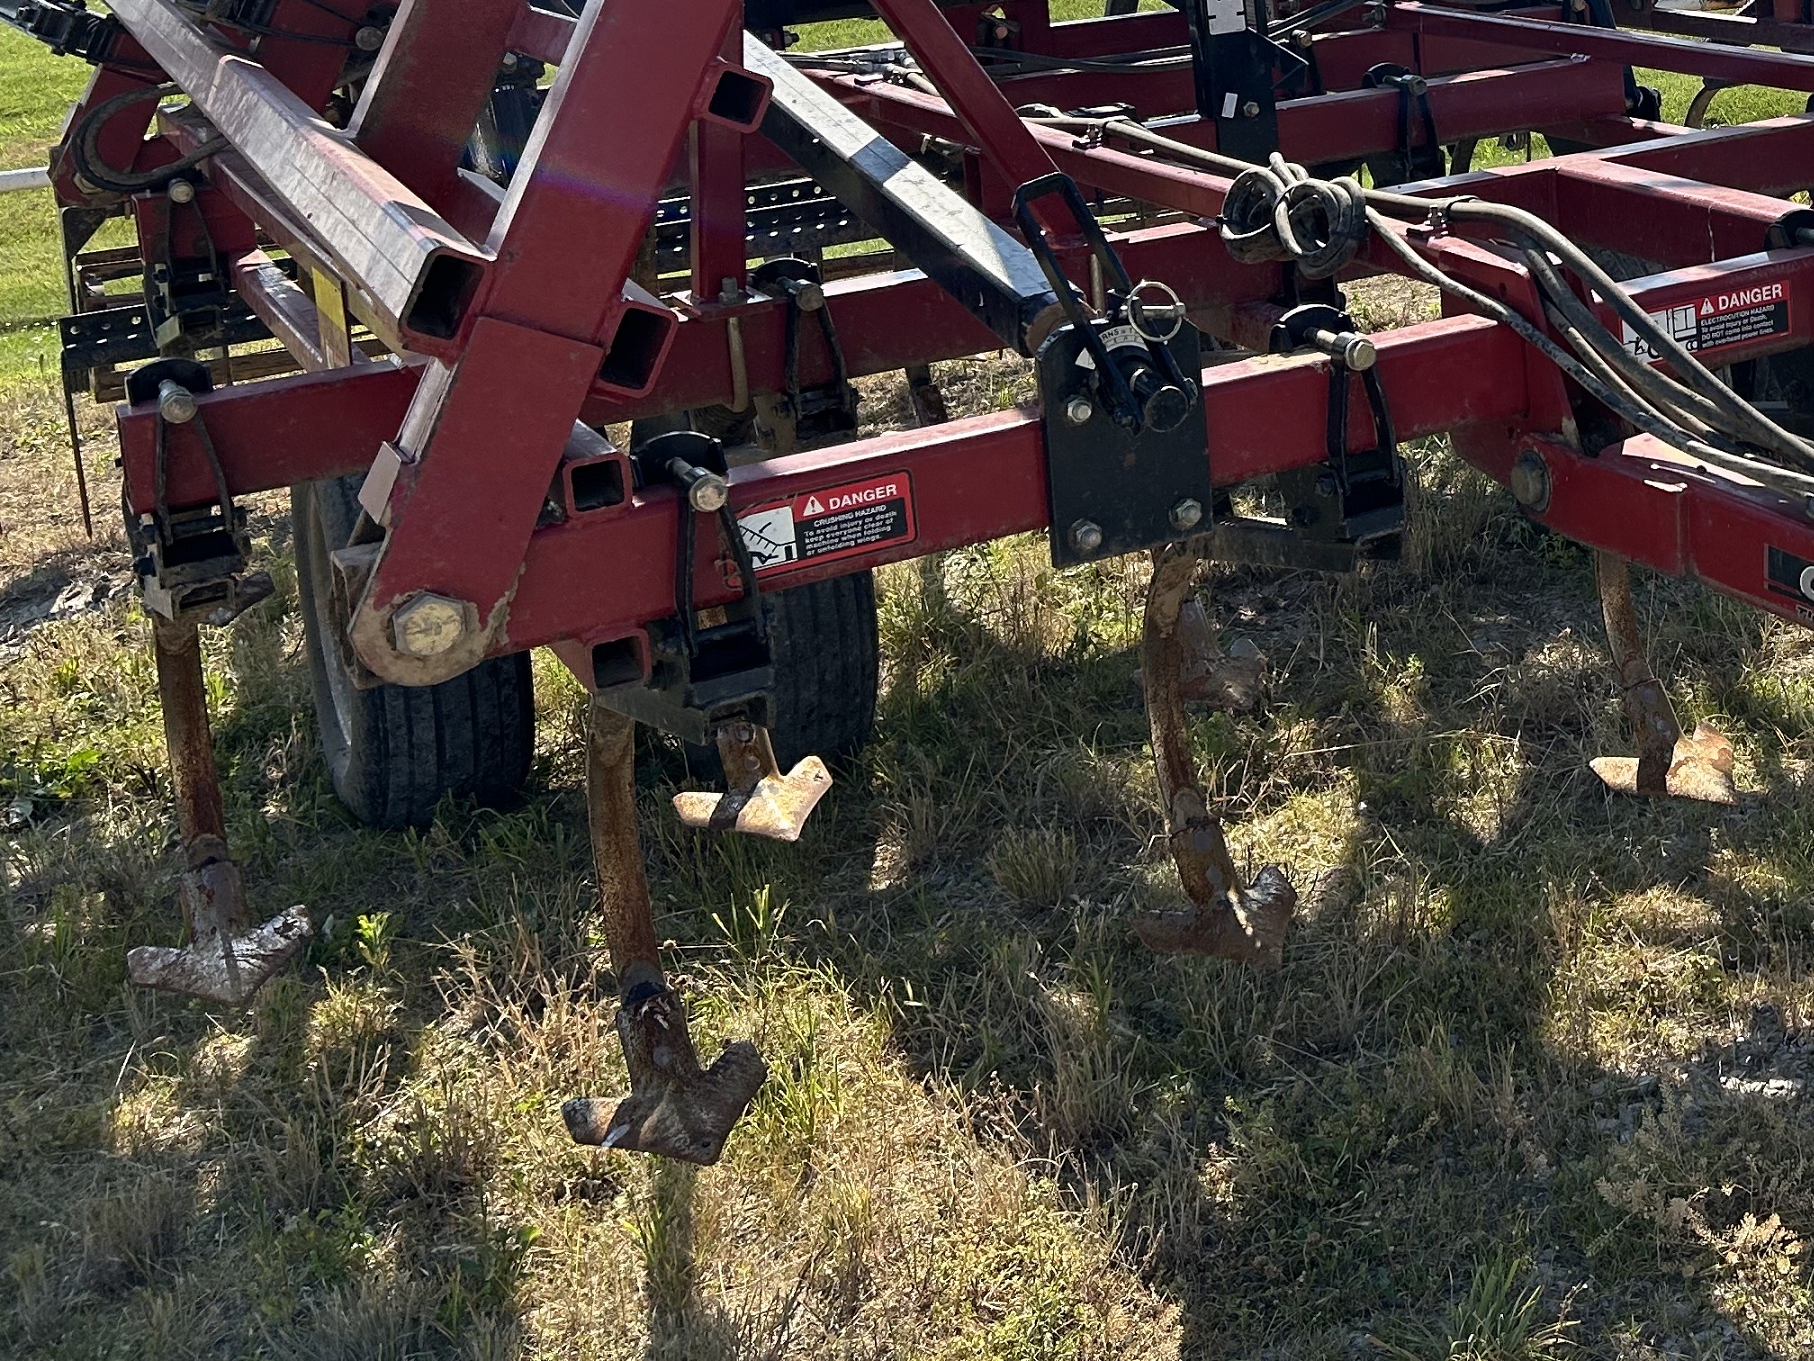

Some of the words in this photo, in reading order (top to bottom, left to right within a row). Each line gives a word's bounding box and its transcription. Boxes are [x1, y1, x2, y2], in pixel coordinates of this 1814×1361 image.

[1718, 283, 1782, 311] DANGER
[1700, 309, 1750, 327] ELECTROCUTION
[1750, 304, 1775, 315] HAZARD
[1709, 323, 1725, 332] avoid
[1711, 330, 1724, 339] NOT
[1753, 319, 1774, 330] contact
[1741, 330, 1758, 341] power
[828, 483, 898, 510] DANGER
[813, 512, 854, 527] CRUSHING
[855, 504, 887, 518] HAZARD
[815, 524, 838, 535] avoid
[840, 519, 863, 531] injury
[875, 510, 897, 521] death
[805, 534, 824, 544] keep
[825, 526, 862, 539] everyone
[864, 520, 883, 530] clear
[805, 538, 839, 550] machine
[841, 532, 862, 541] when
[863, 525, 892, 536] folding
[817, 540, 855, 553] unfolding
[857, 534, 881, 545] wings.
